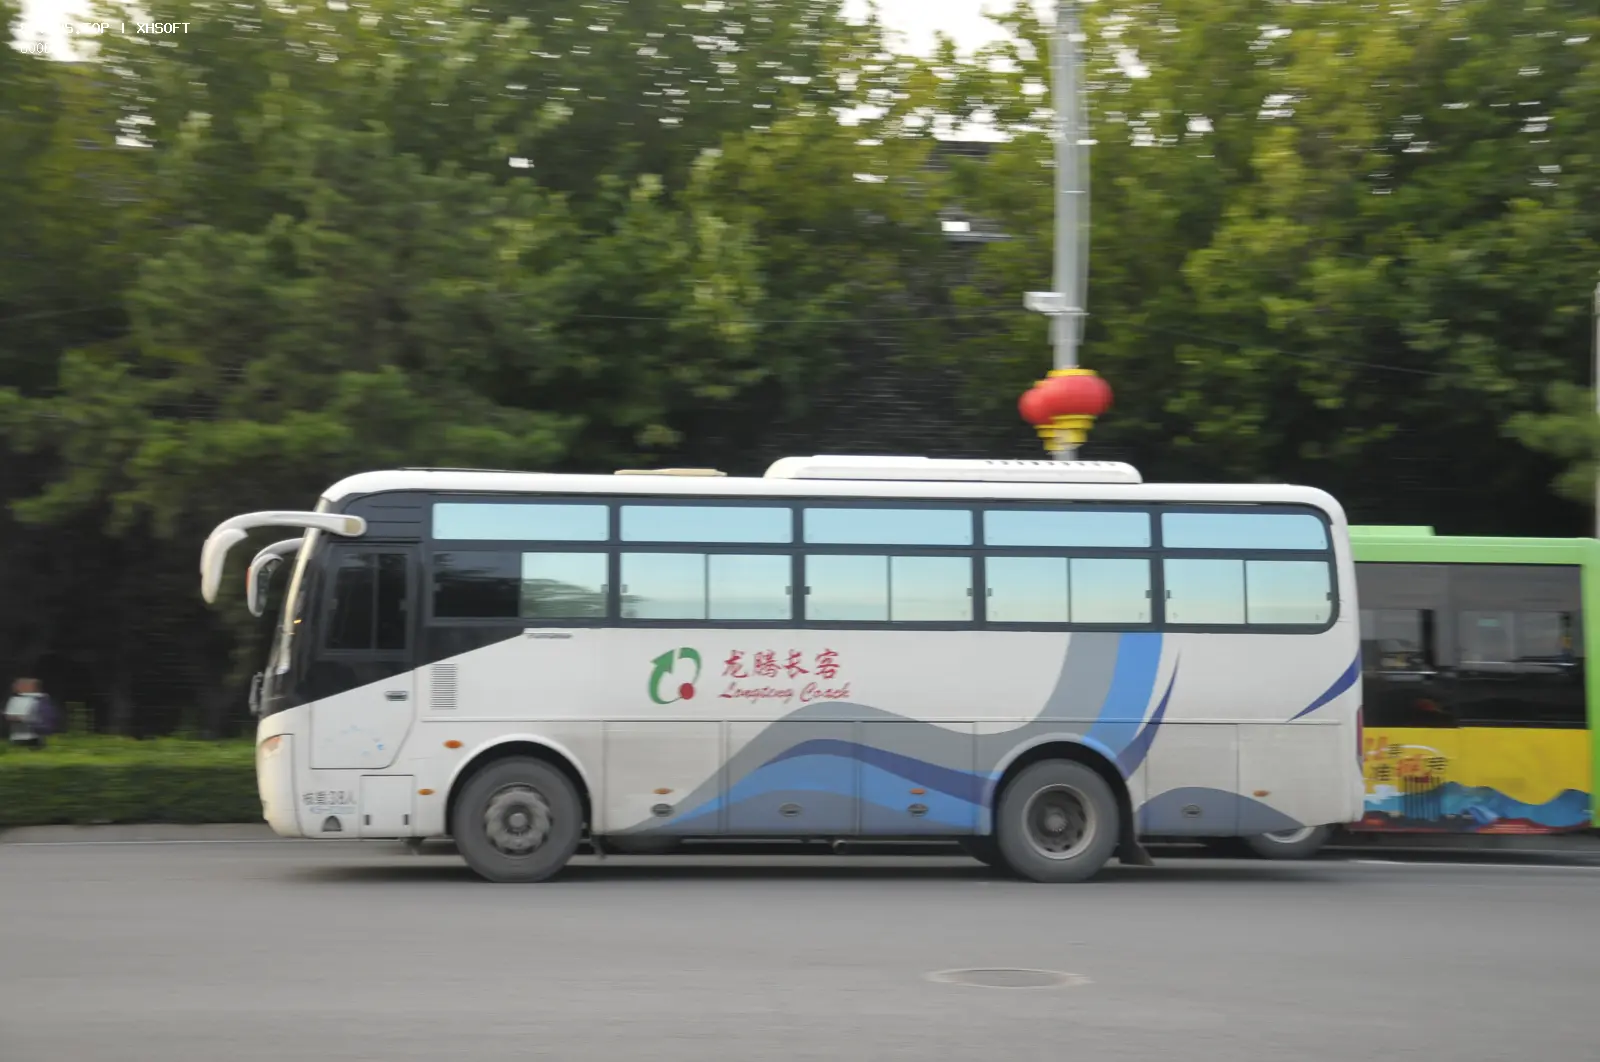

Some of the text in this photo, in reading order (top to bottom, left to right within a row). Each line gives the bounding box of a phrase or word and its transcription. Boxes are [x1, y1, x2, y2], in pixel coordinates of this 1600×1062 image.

[722, 648, 840, 679] 龙腾长客
[800, 682, 851, 702] Coach
